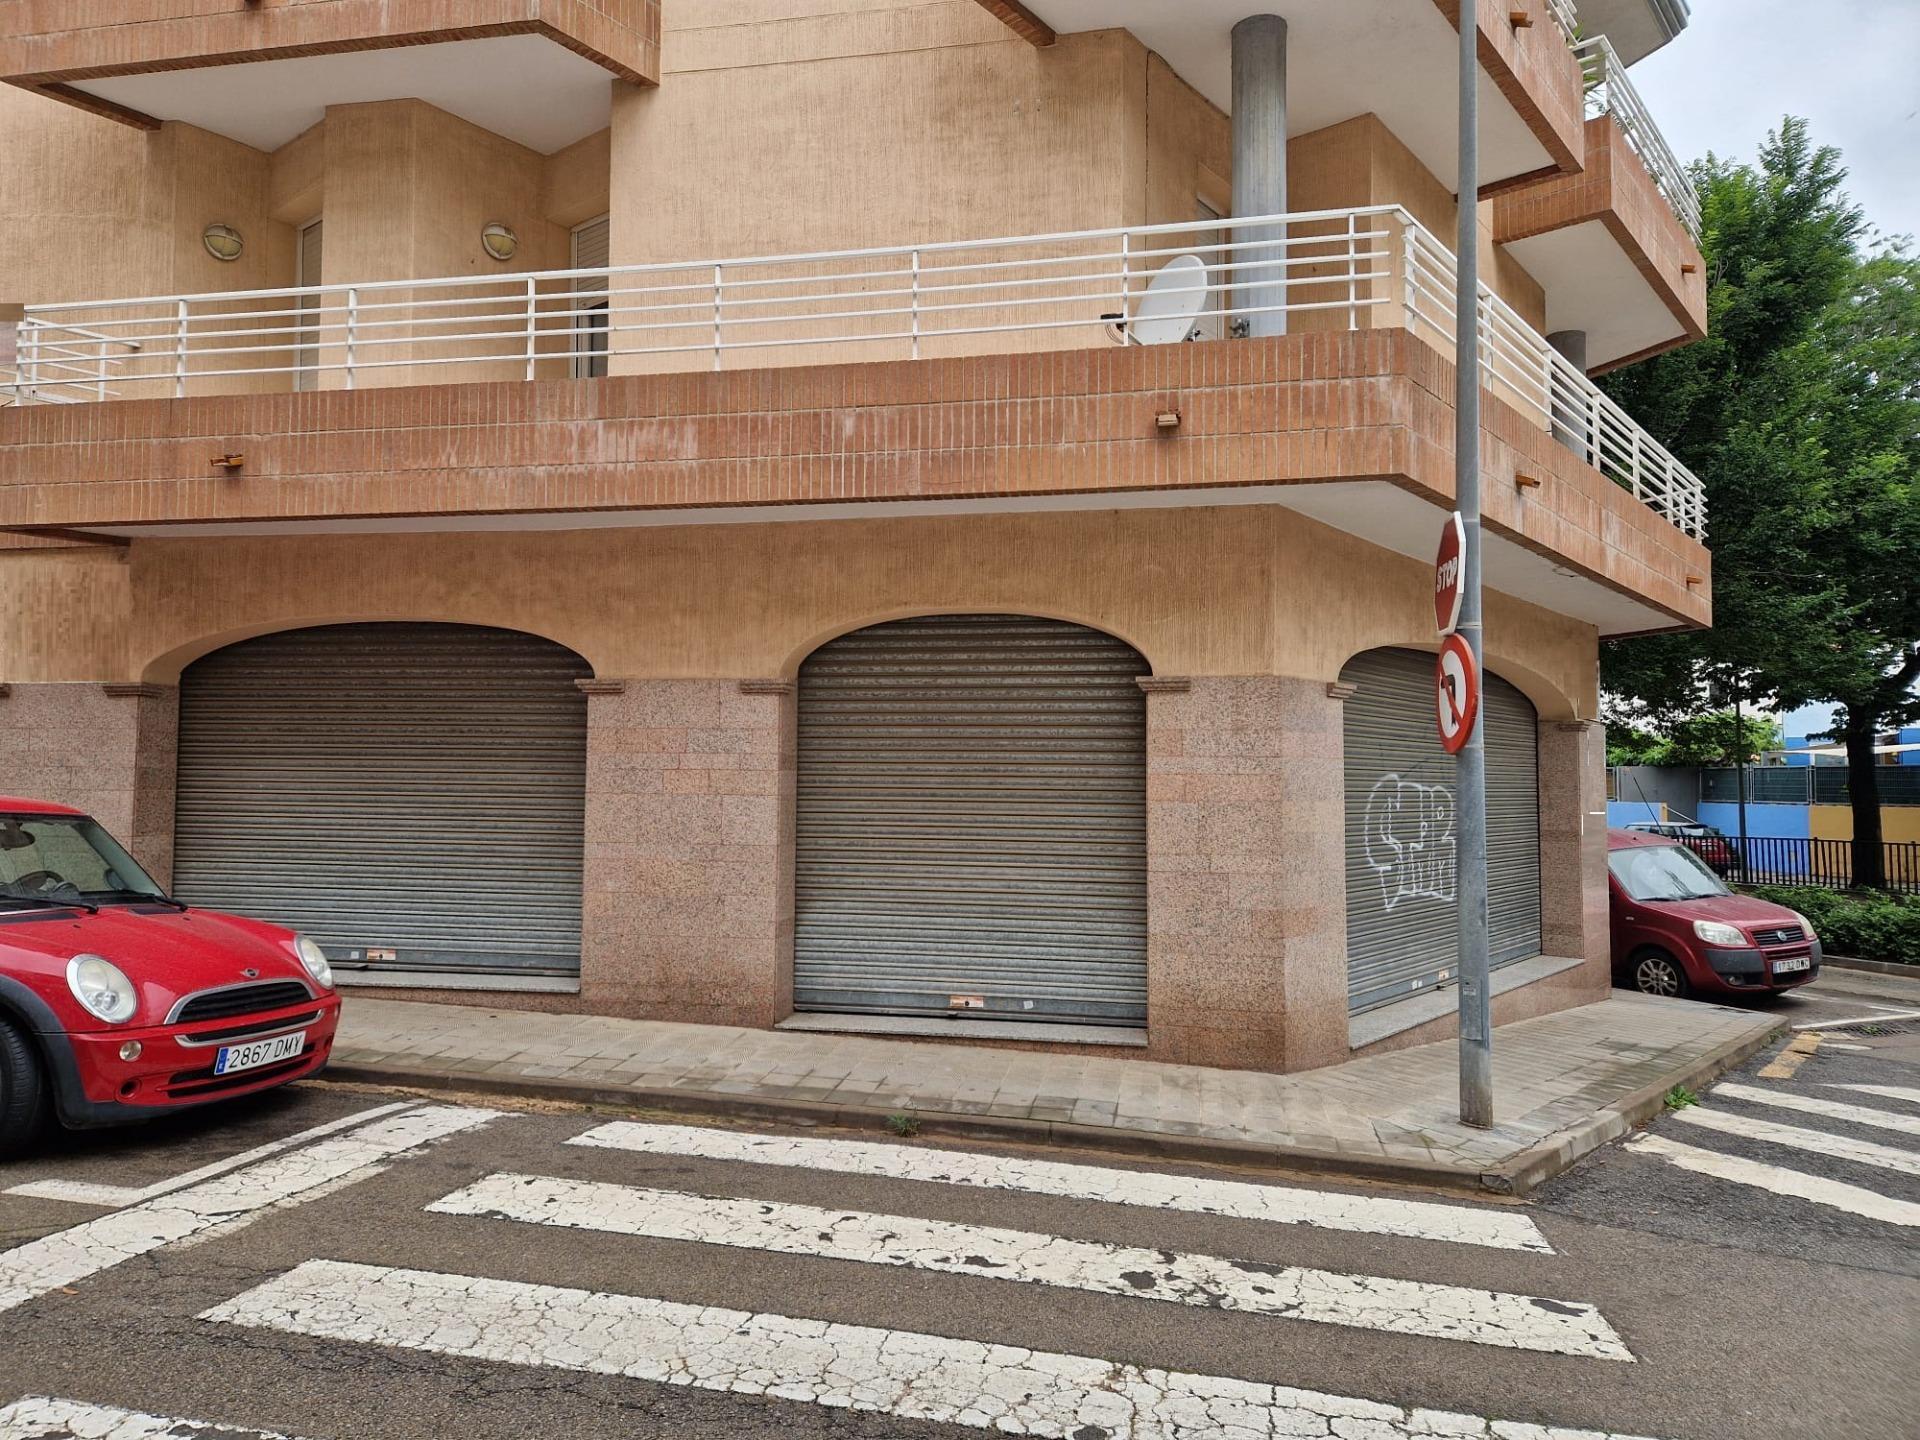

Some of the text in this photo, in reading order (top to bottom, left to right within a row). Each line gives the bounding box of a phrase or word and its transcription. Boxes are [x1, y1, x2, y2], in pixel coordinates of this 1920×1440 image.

[1437, 556, 1458, 593] STOP
[228, 1035, 303, 1069] 2867 DMY
